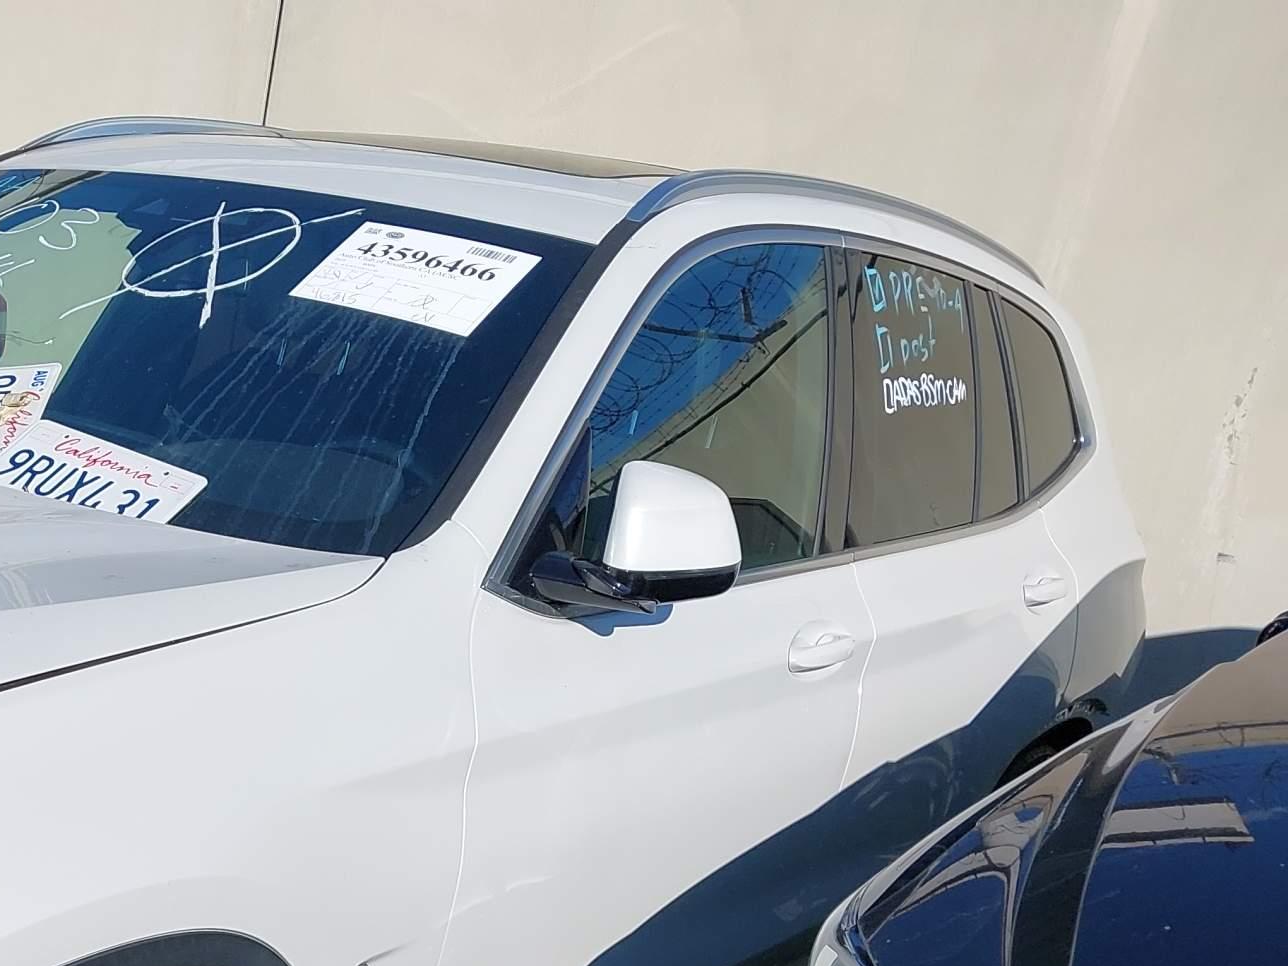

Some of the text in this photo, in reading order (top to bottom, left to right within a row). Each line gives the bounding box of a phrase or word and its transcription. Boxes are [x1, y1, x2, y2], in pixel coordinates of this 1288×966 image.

[356, 241, 502, 282] 43596466
[31, 370, 49, 388] AUG
[54, 438, 158, 488] California
